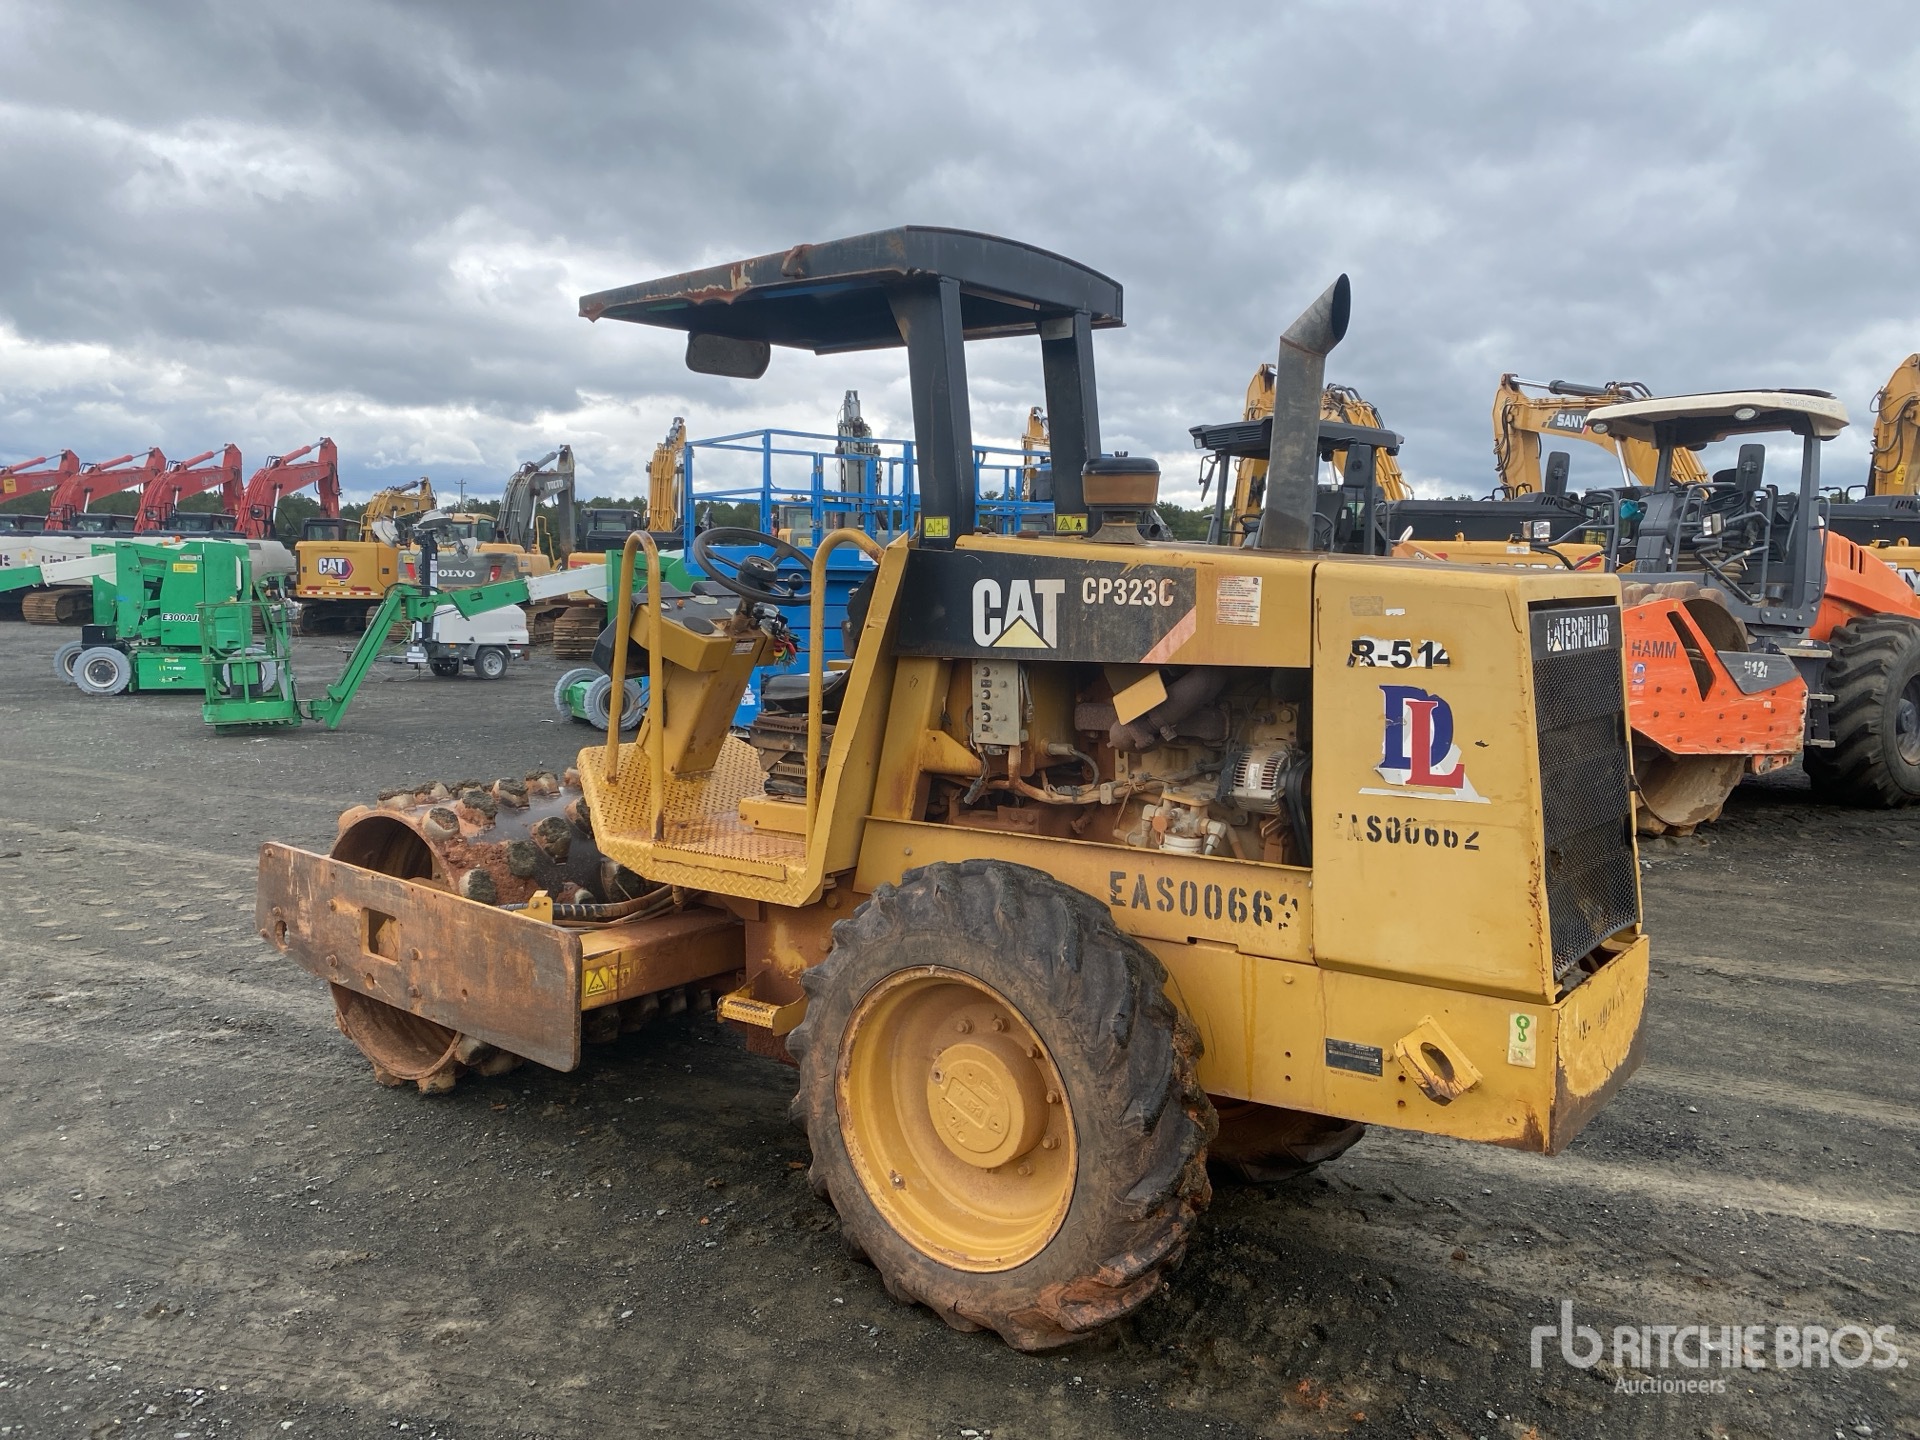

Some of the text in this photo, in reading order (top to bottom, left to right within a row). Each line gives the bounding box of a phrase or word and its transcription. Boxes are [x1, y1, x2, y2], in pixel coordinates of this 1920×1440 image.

[1556, 413, 1587, 429] SANY
[546, 479, 564, 491] VOLVO
[318, 557, 345, 575] CAT
[438, 569, 476, 578] OLVO
[1082, 577, 1174, 607] CP323C
[162, 613, 199, 622] E300AJ
[972, 578, 1065, 648] CAT
[1547, 614, 1609, 652] CATERPILLAR
[1632, 640, 1677, 658] HAMM
